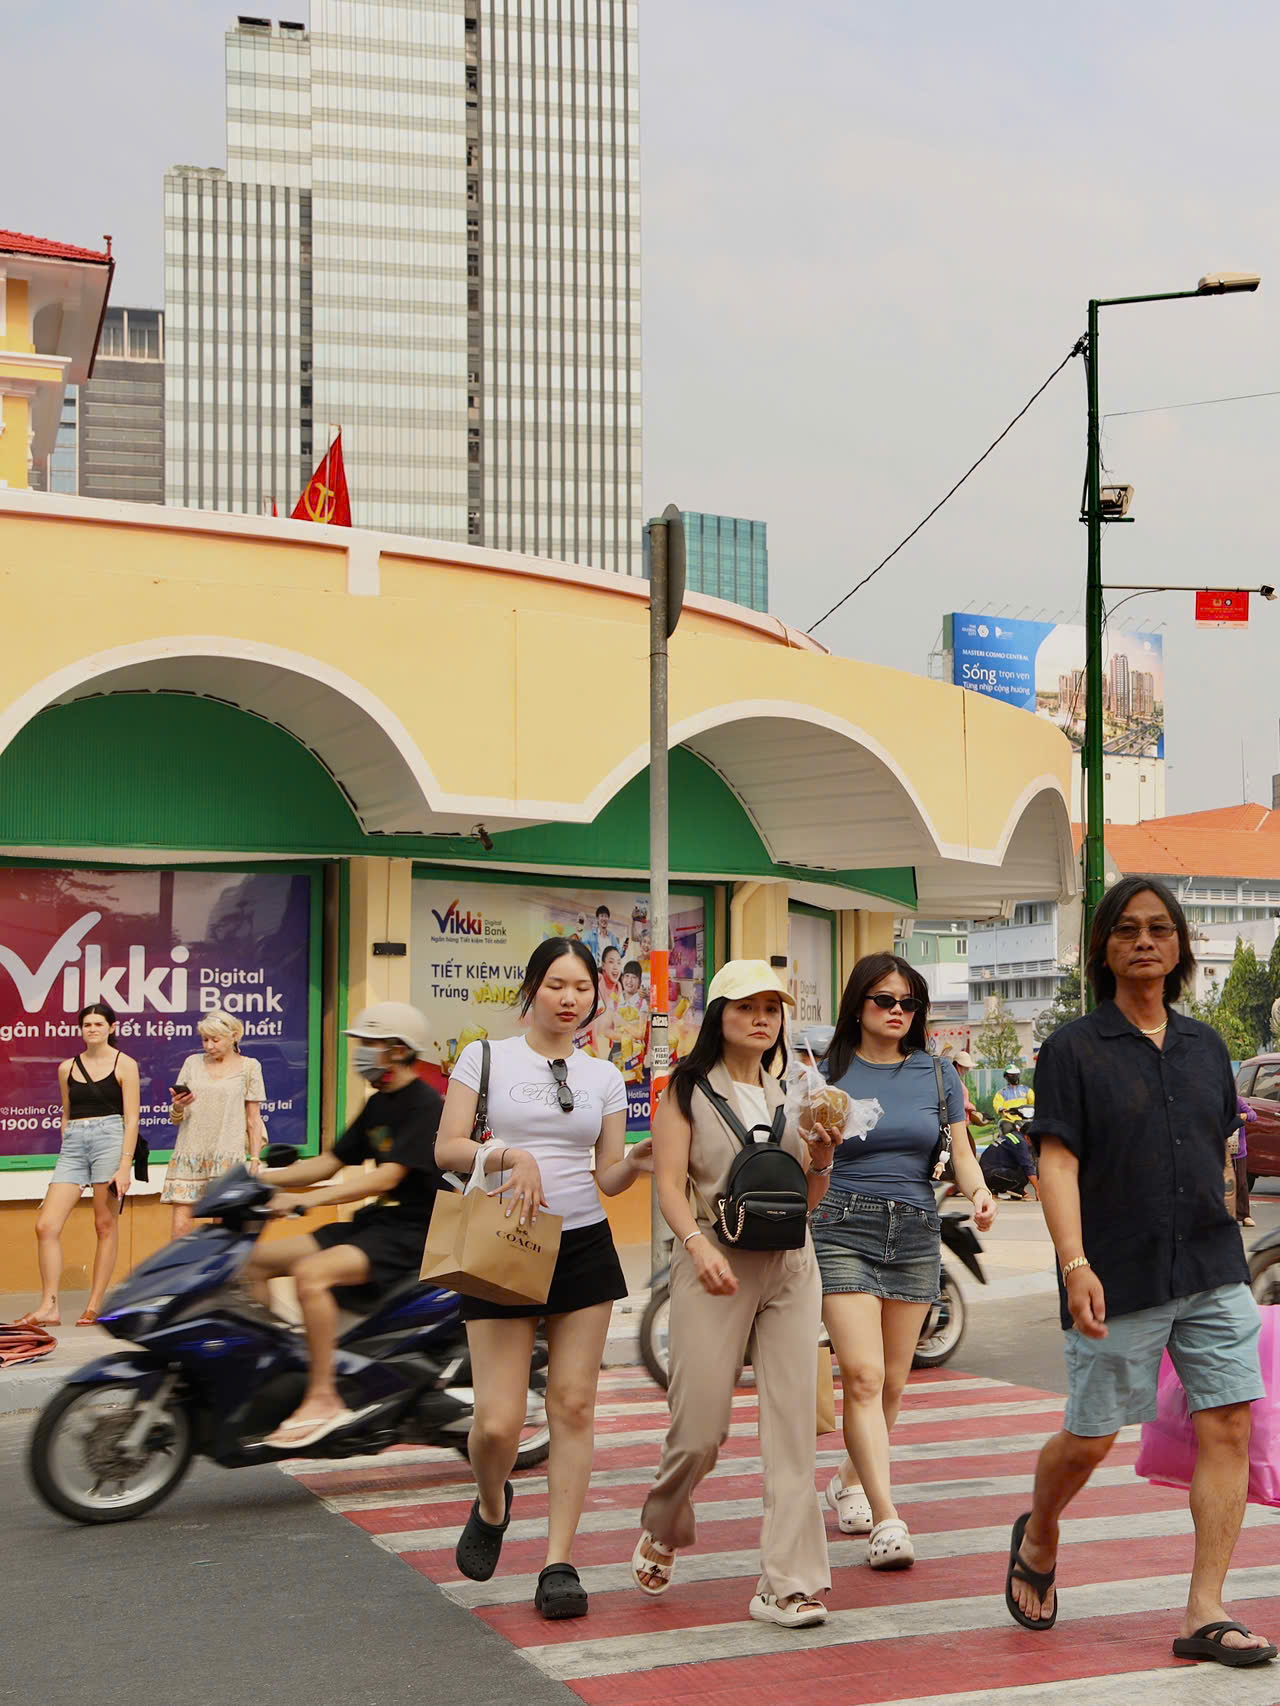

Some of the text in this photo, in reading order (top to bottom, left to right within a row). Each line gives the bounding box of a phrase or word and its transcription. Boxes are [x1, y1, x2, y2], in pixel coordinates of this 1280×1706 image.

[962, 649, 985, 657] MASTERI
[962, 662, 997, 685] Sống
[999, 671, 1015, 680] trọn
[431, 898, 482, 936] Vikki
[485, 926, 507, 936] Bank
[0, 911, 190, 1013] Vikki
[431, 958, 526, 984] TIẾT KIỆM Vik
[200, 968, 264, 988] Digital
[200, 986, 284, 1013] Bank
[431, 984, 469, 1002] Trúng
[800, 999, 822, 1022] Bank
[0, 1018, 283, 1042] gân hàn iết kiệm hất!
[627, 1090, 650, 1099] Hotline
[10, 1104, 64, 1117] Hotline (24
[277, 1100, 293, 1111] lai
[628, 1102, 651, 1119] 190
[0, 1117, 62, 1131] 1900 66
[496, 1230, 541, 1253] COACH
